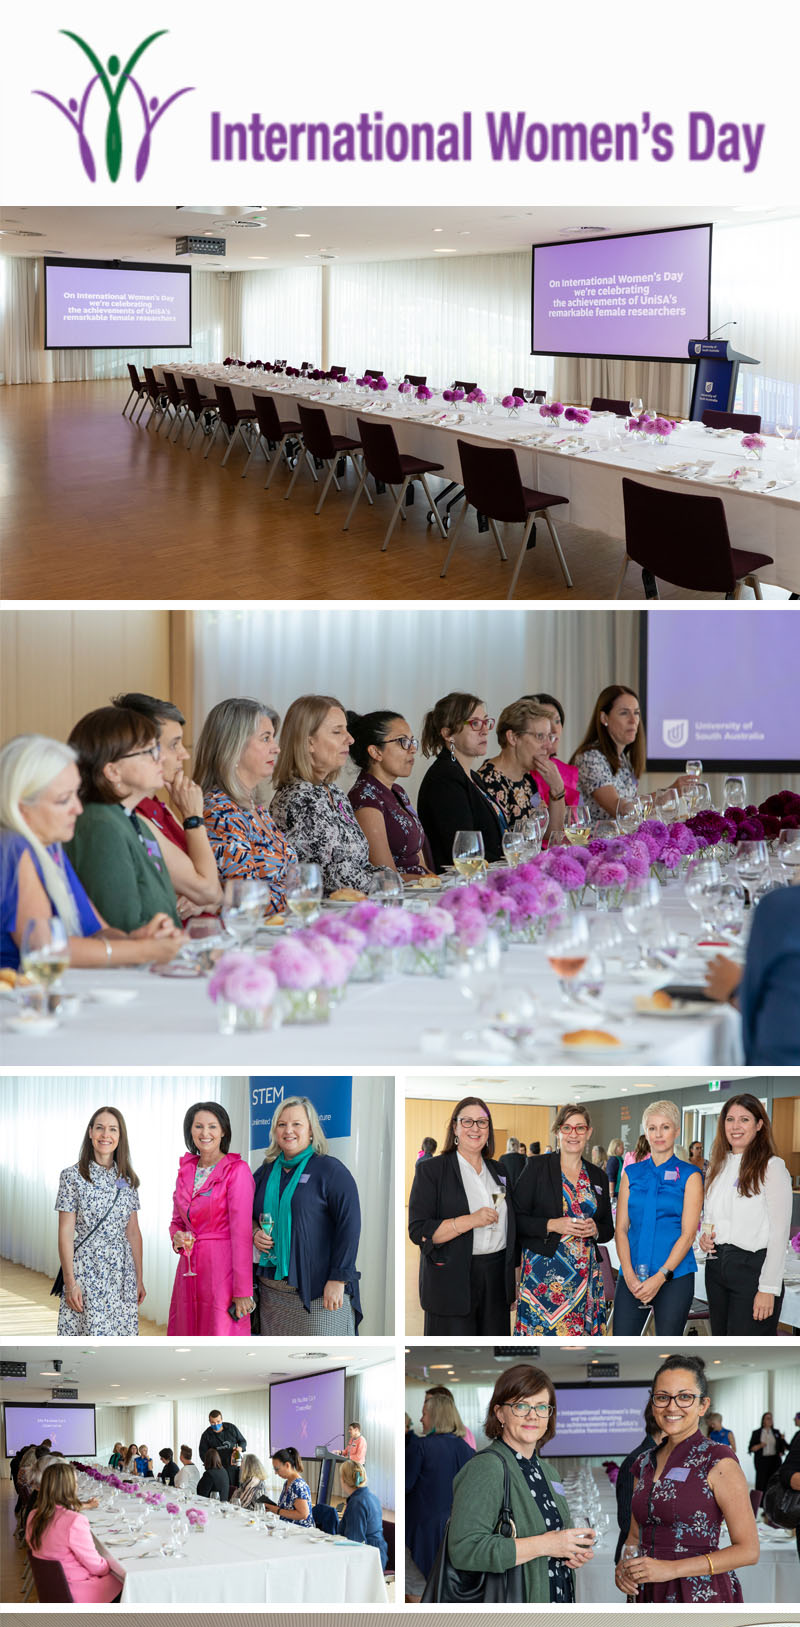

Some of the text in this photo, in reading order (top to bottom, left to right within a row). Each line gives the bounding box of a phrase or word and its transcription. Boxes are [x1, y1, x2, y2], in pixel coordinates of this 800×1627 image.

[562, 275, 616, 287] International
[664, 272, 683, 282] Day
[598, 284, 650, 295] celebrating
[77, 292, 126, 300] International
[553, 298, 566, 307] the
[568, 296, 626, 307] achievements
[628, 296, 638, 305] of
[549, 306, 686, 317] remarkable female researchers
[695, 721, 752, 731] University of
[695, 732, 765, 741] South Australia
[252, 1086, 284, 1105] STEM
